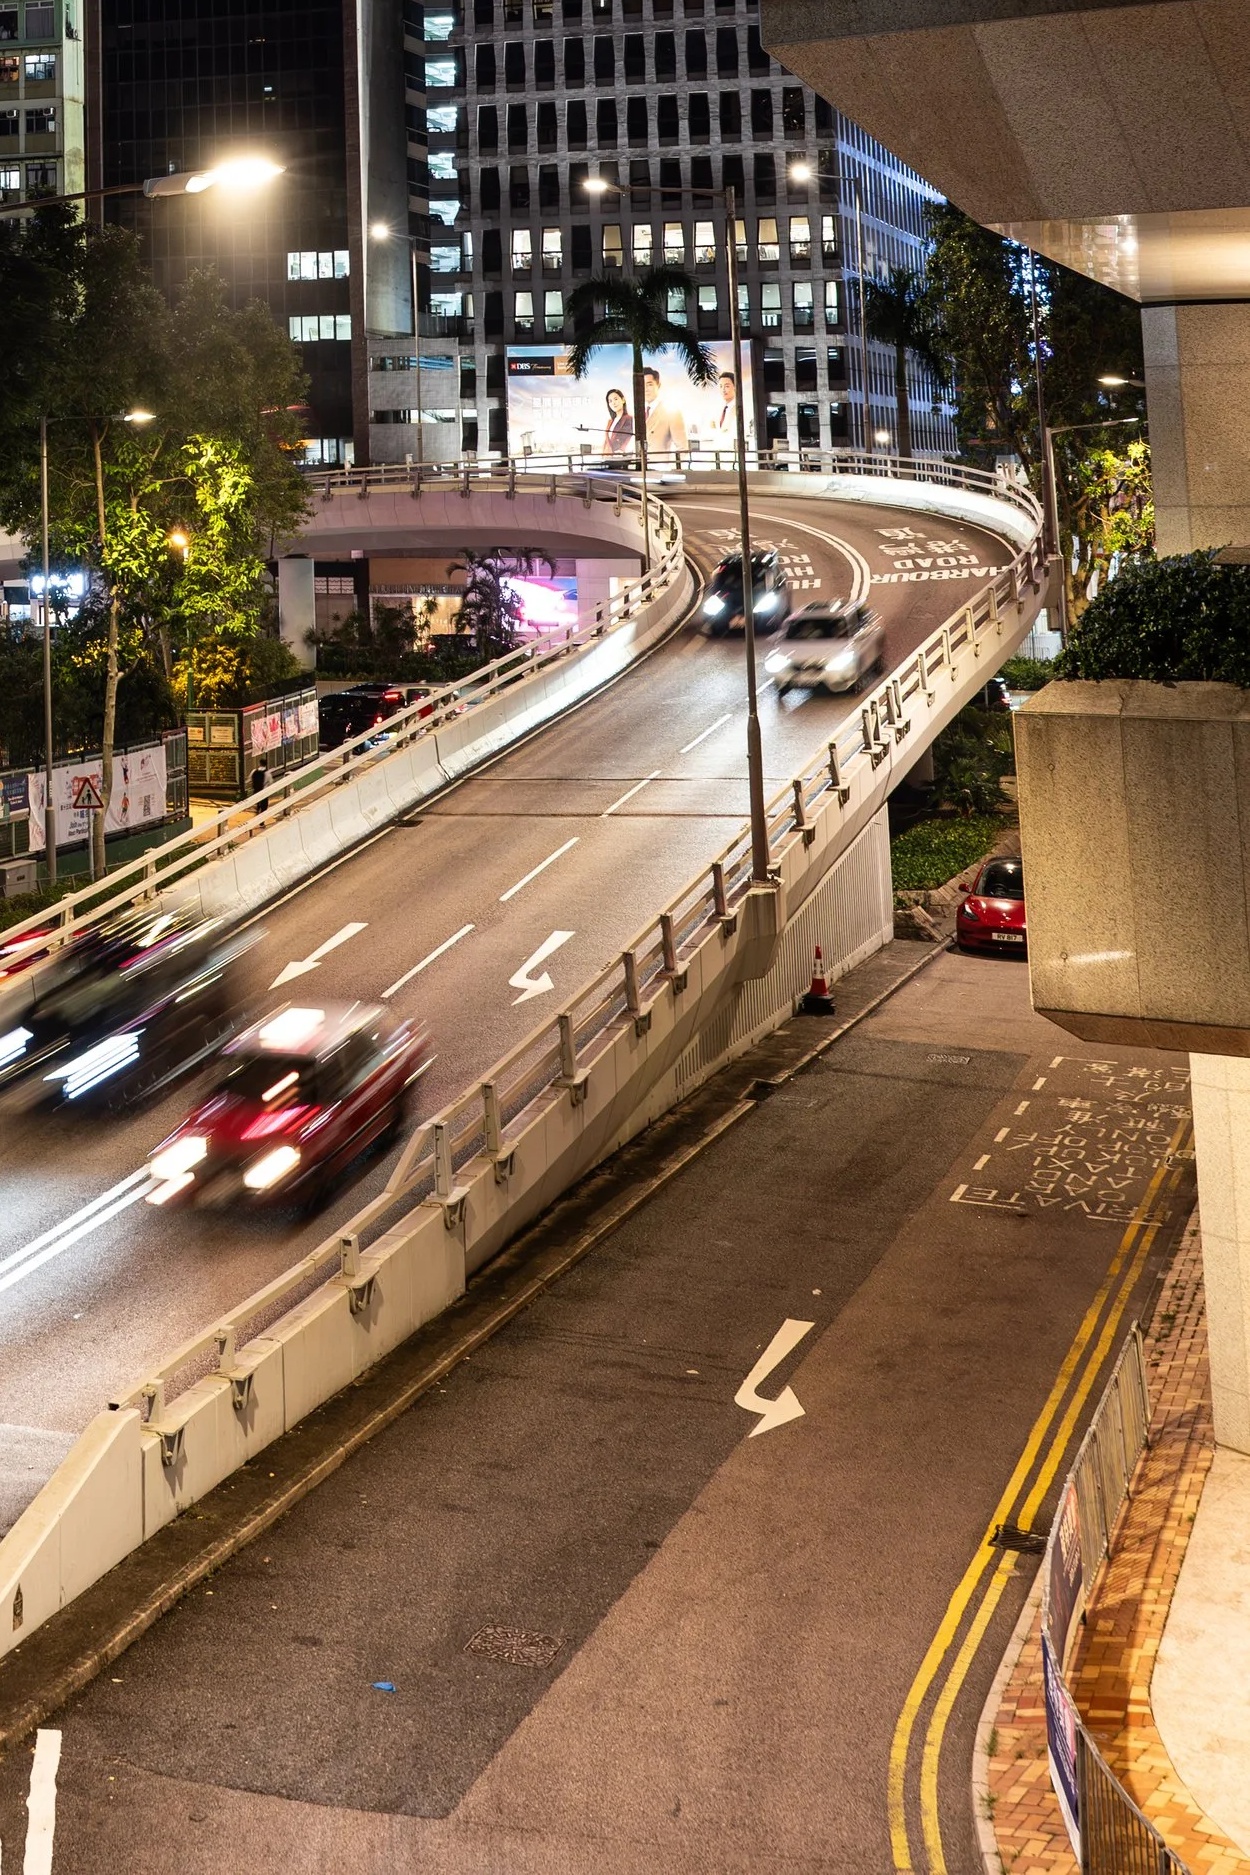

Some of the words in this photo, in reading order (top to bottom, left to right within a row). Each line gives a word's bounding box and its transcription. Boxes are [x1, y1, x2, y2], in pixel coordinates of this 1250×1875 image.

[893, 554, 980, 569] ROAD
[870, 565, 1010, 584] HARBOUR
[1114, 1089, 1152, 1103] 及
[1013, 1132, 1087, 1147] OFF
[1053, 1124, 1171, 1144] ONLY
[1096, 1142, 1195, 1160] DROP
[1097, 1151, 1183, 1171] PICK
[1032, 1156, 1142, 1178] TAXI
[1032, 1169, 1134, 1189] AND
[1024, 1180, 1126, 1202] CAR
[965, 1187, 1174, 1222] PRIVATE
